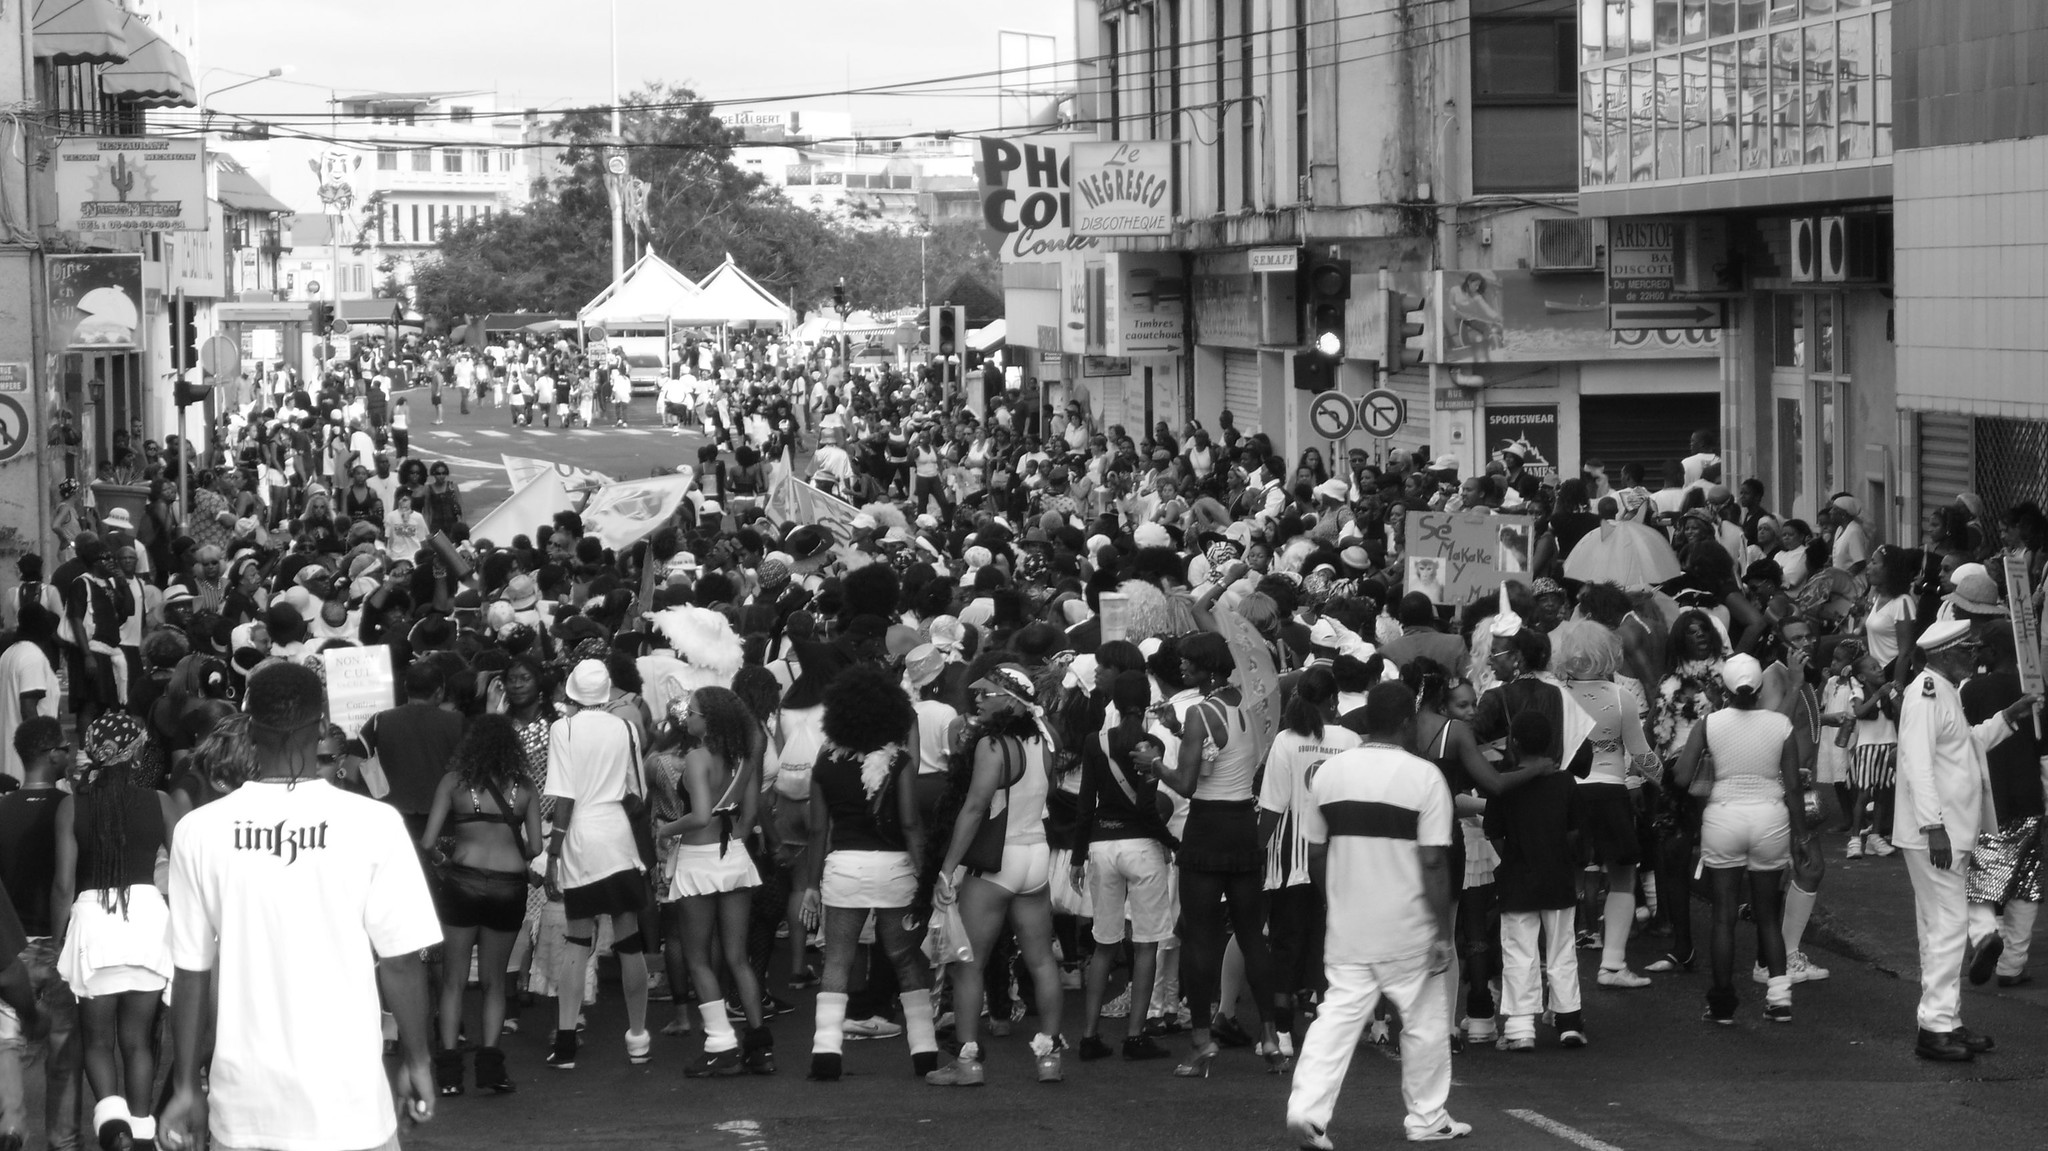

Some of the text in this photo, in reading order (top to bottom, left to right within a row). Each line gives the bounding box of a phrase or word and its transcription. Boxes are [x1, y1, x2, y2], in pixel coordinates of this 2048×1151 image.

[97, 141, 169, 150] RESTAURANT
[1103, 143, 1141, 167] Le
[1077, 168, 1167, 209] NEGRESCO
[1080, 214, 1166, 232] DISCOTHEQUE
[1613, 280, 1671, 289] Du MERCREDI
[1626, 291, 1636, 301] de
[1134, 318, 1174, 328] Timbres
[1125, 330, 1183, 340] caoutchouc
[1489, 414, 1555, 425] SPORTSWEAR
[1419, 515, 1453, 541] Sé
